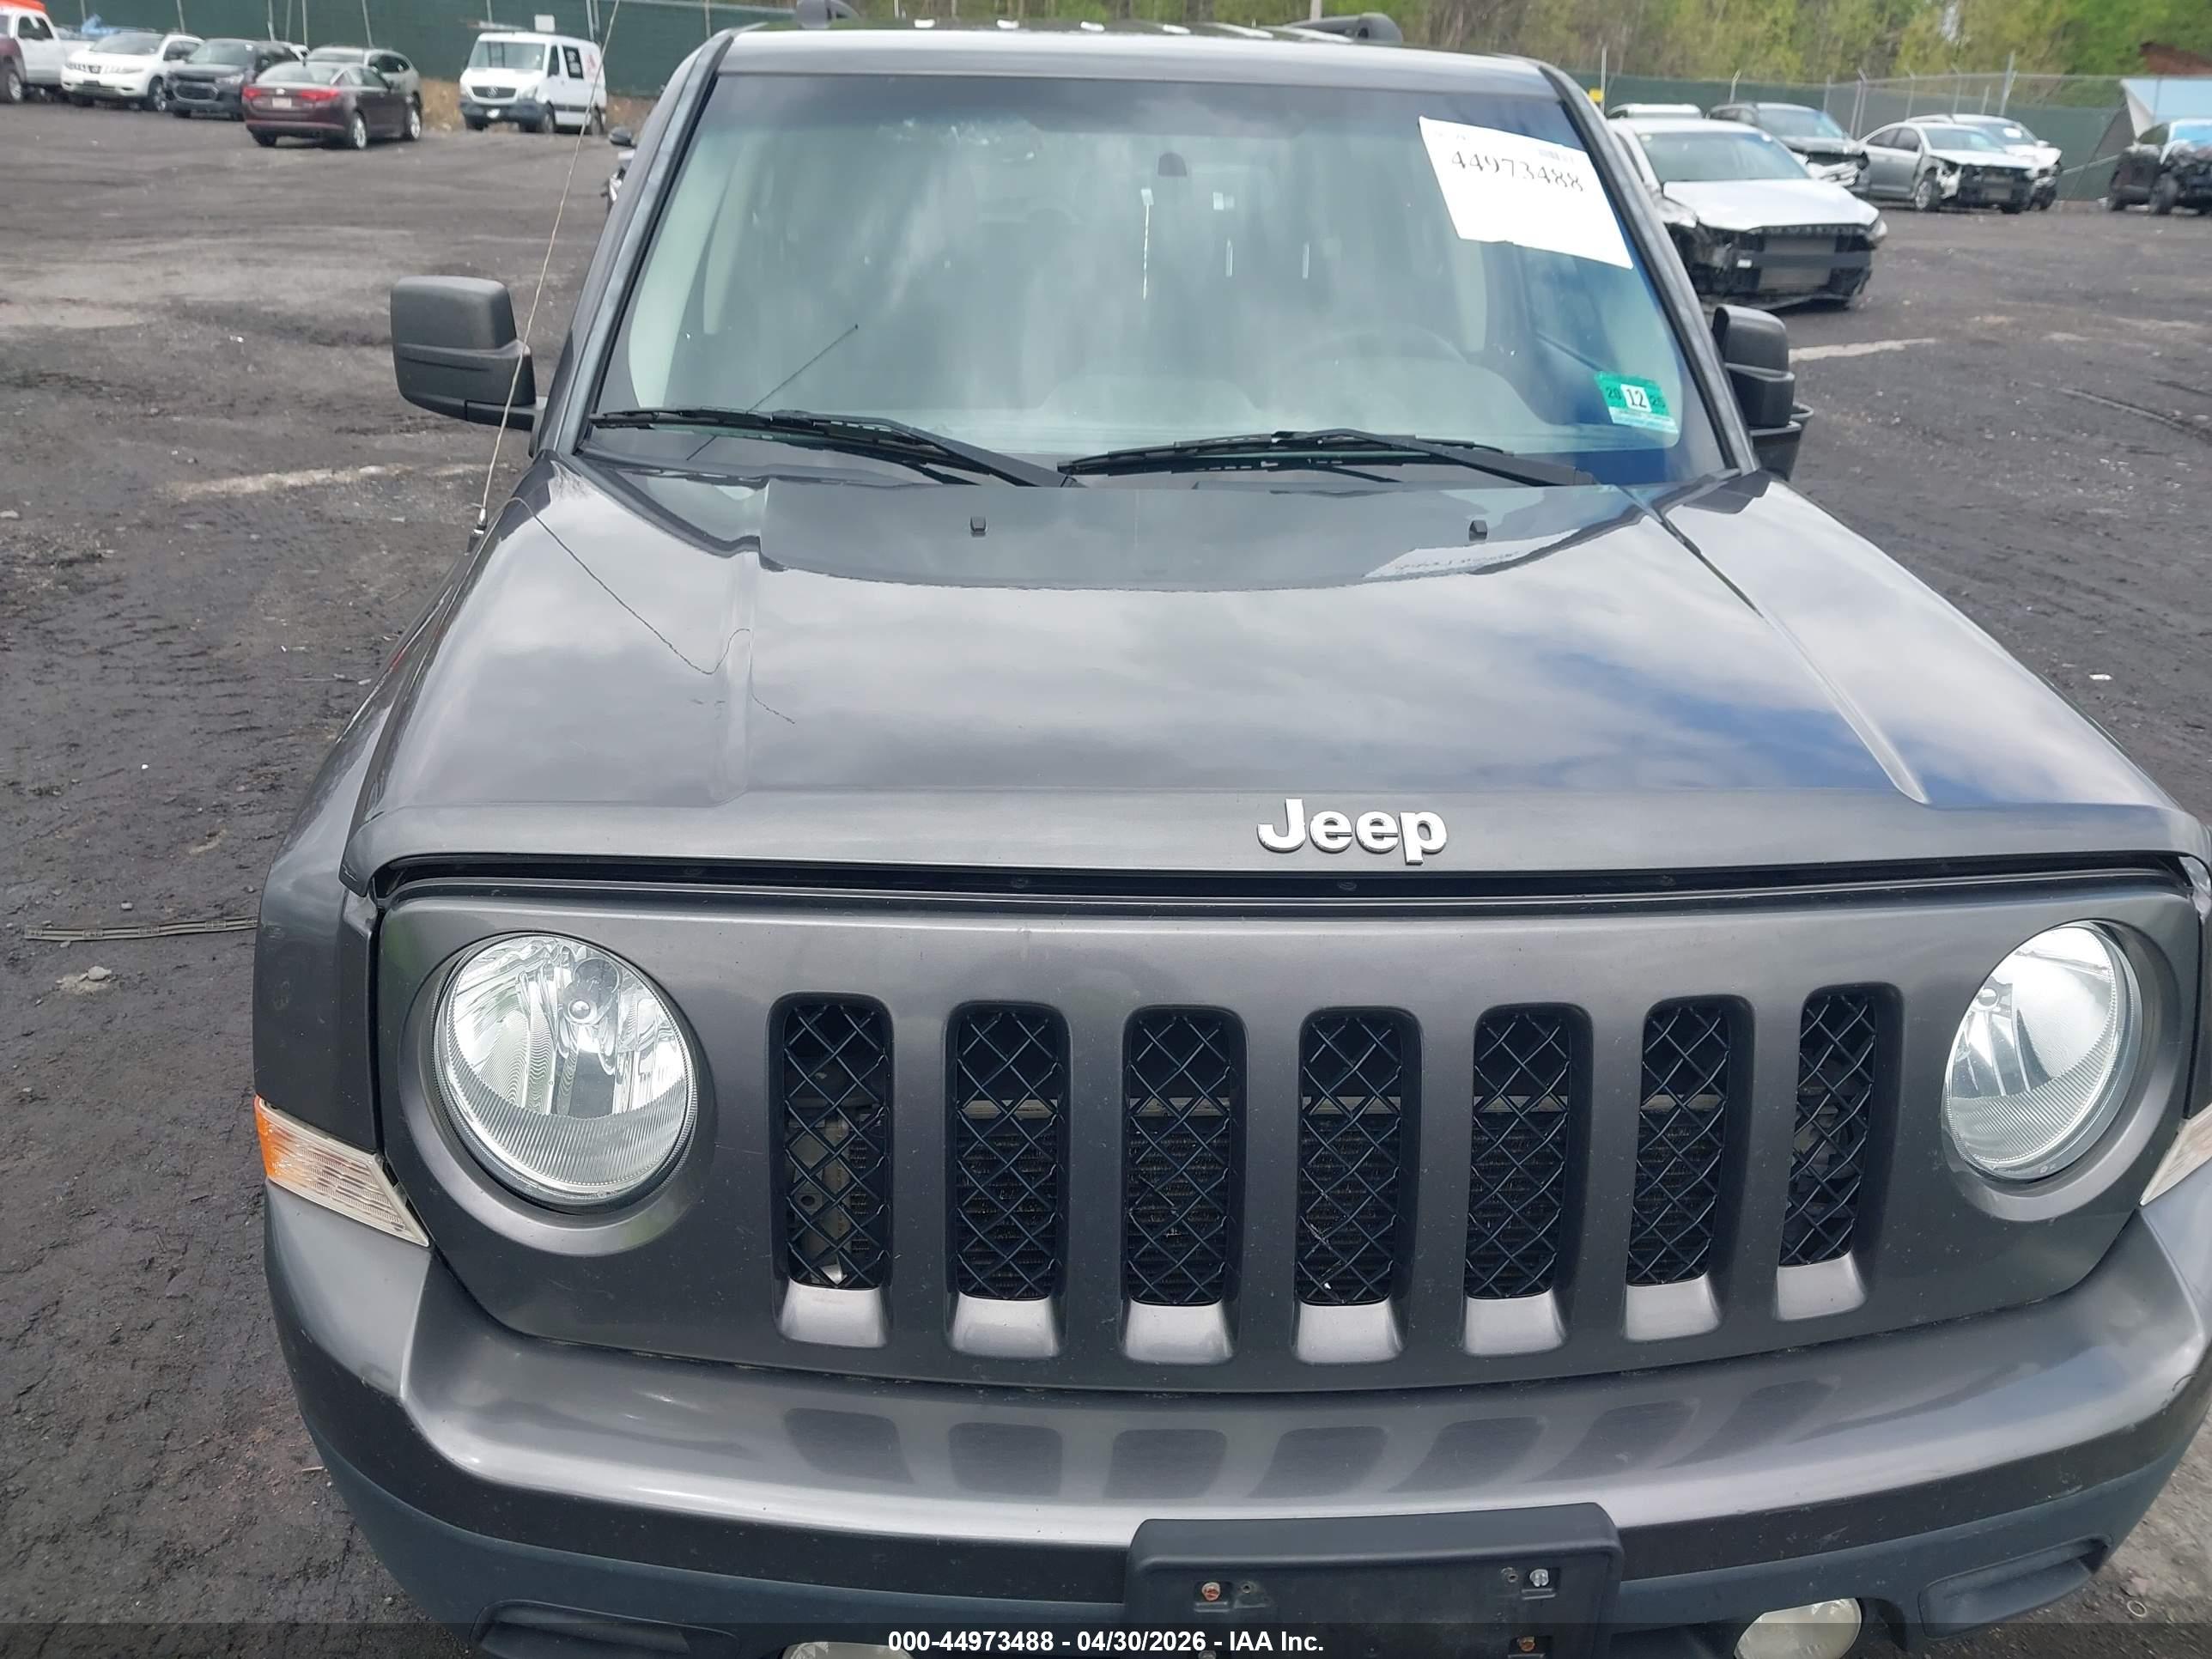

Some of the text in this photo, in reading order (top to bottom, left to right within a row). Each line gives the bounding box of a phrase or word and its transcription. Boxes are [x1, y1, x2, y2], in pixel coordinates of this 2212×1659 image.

[1451, 150, 1583, 191] 44973488
[1606, 386, 1622, 401] 20
[1626, 388, 1648, 409] 12
[1257, 798, 1448, 866] Jeep
